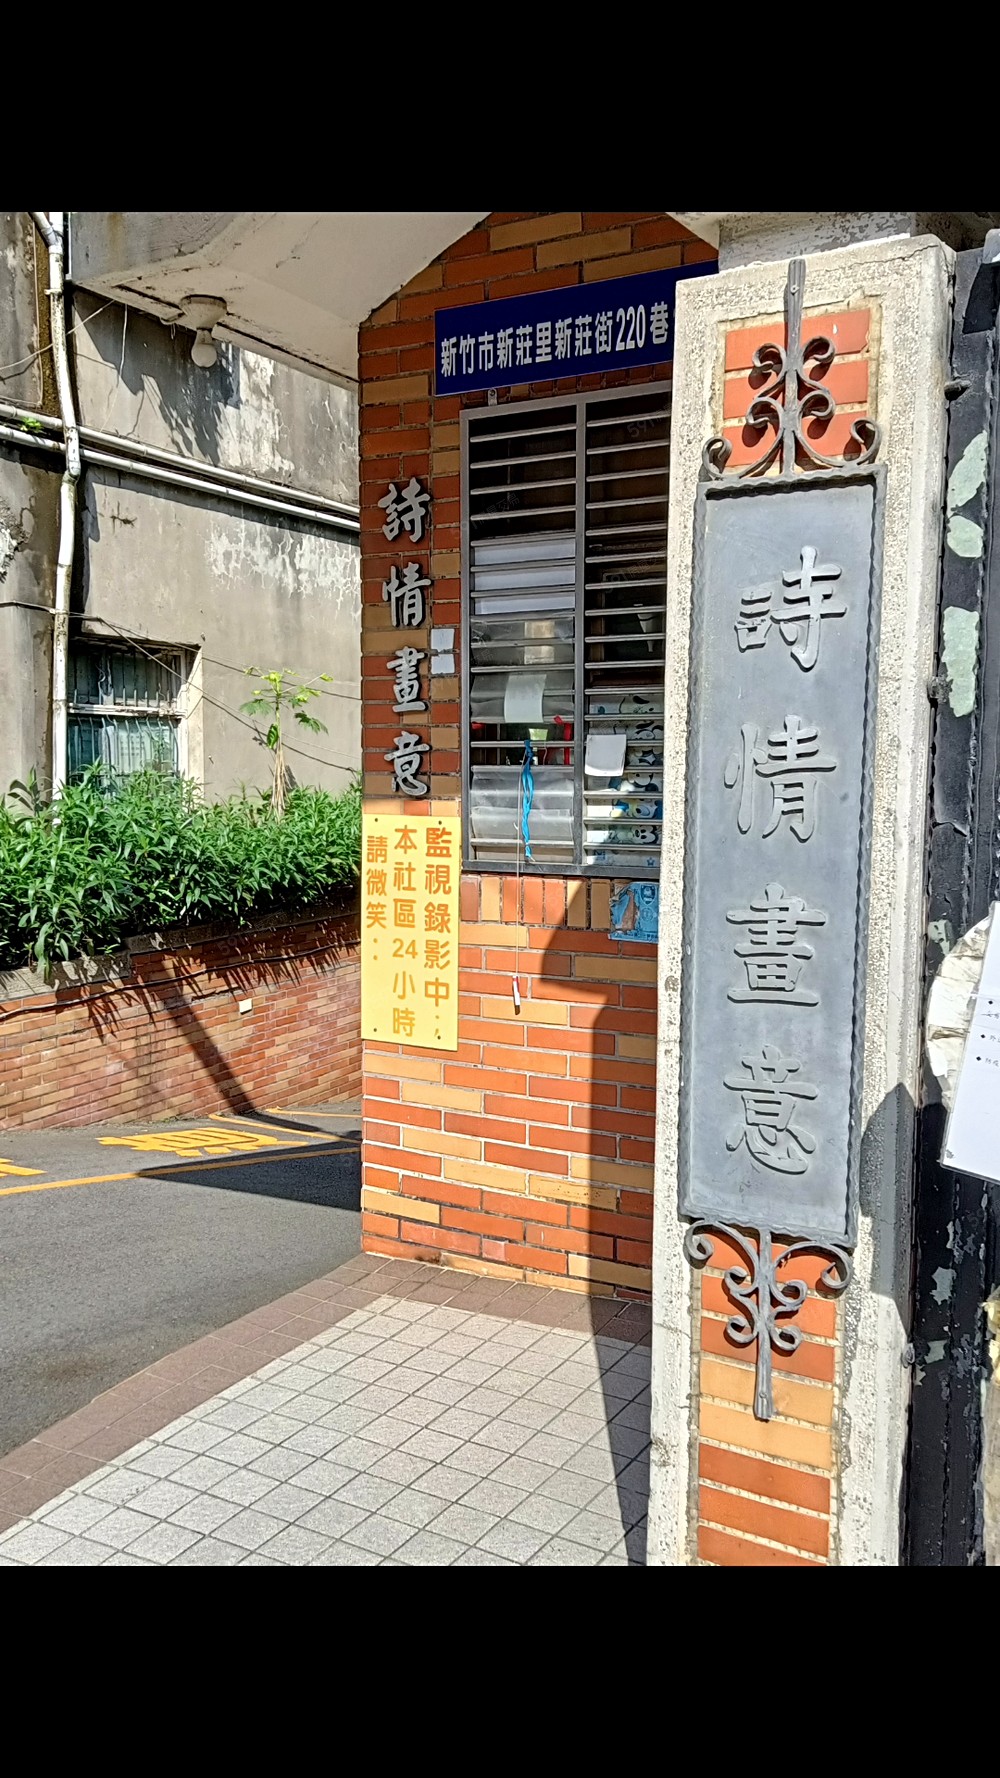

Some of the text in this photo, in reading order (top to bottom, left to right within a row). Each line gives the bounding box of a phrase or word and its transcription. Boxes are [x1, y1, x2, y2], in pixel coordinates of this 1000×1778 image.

[440, 301, 676, 378] 新竹市新莊里新莊街220巷
[378, 477, 431, 797] 詩情畫意
[392, 824, 418, 1037] 本社區24小時
[724, 545, 847, 1174] 詩情畫意
